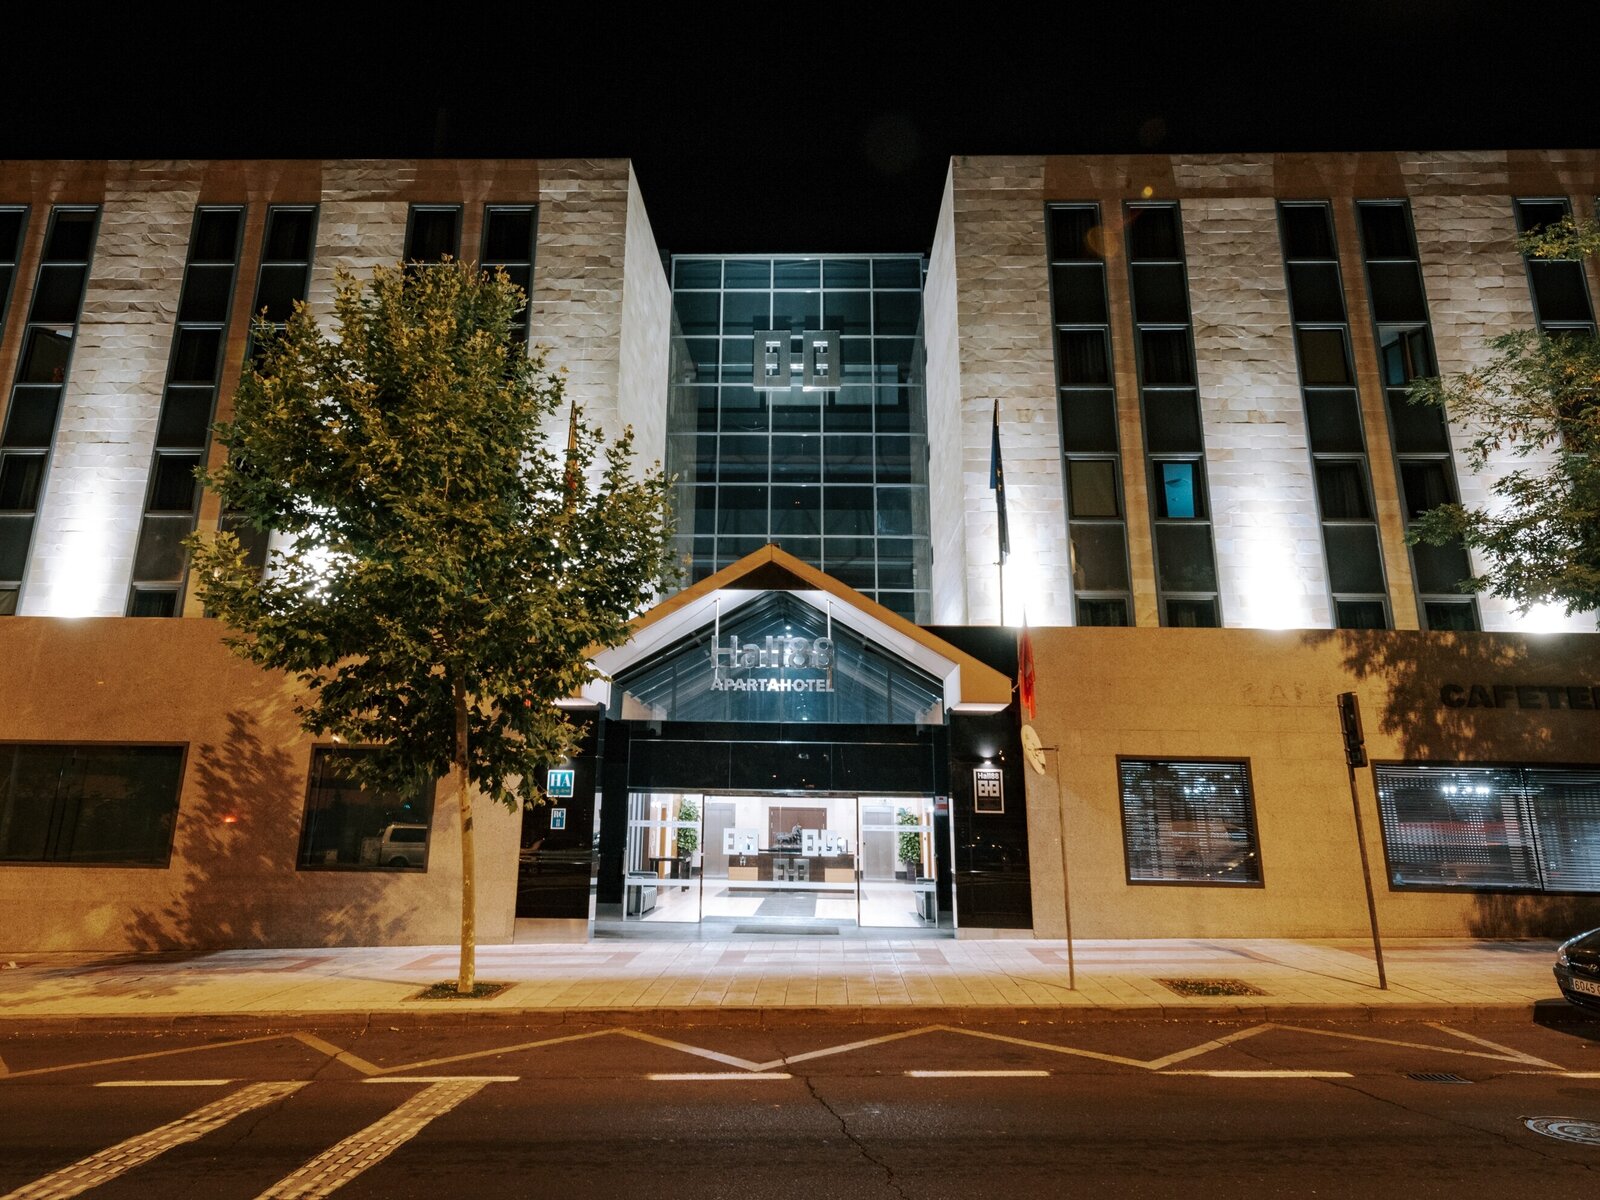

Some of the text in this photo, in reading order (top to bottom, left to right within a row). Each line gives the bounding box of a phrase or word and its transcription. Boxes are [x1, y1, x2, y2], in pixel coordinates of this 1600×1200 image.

[710, 635, 834, 669] Hall88
[710, 678, 834, 692] APARTAHOTEL
[1440, 683, 1600, 711] CAFETE
[550, 773, 571, 787] HA
